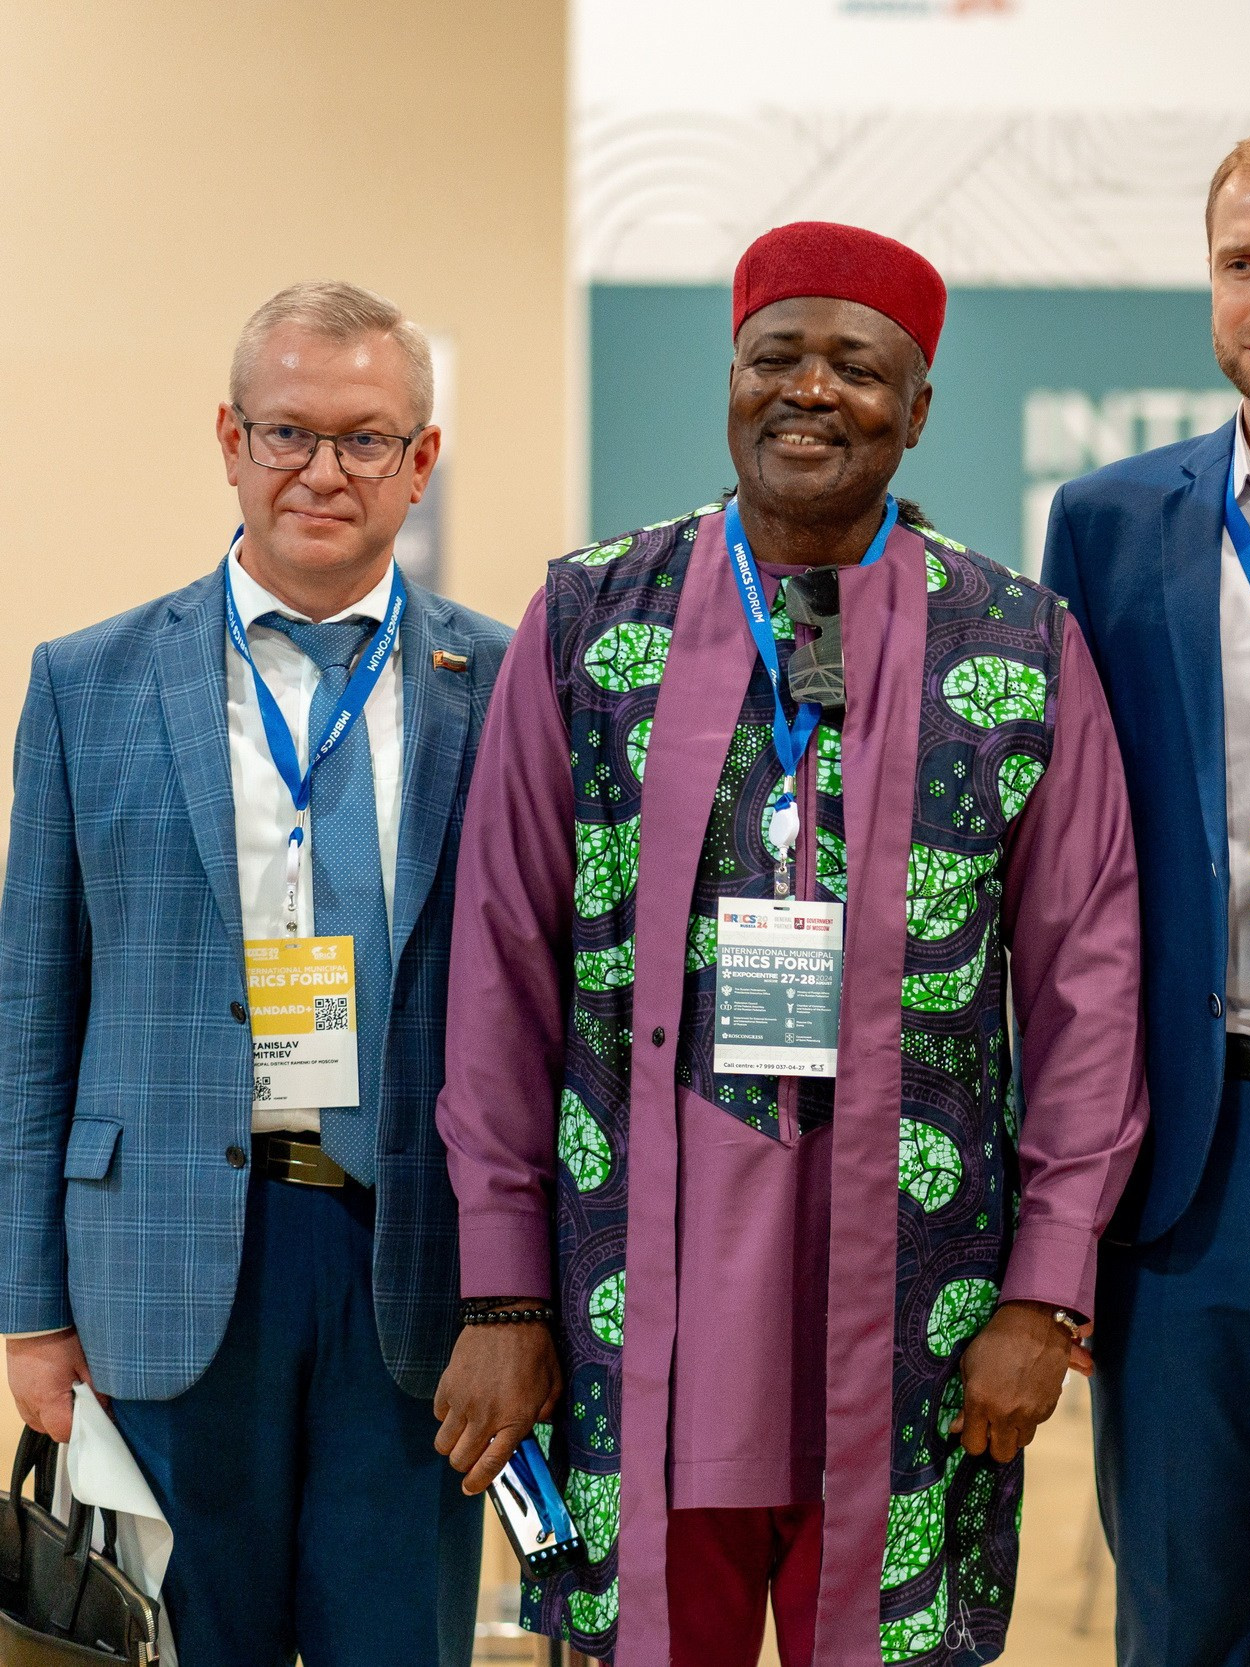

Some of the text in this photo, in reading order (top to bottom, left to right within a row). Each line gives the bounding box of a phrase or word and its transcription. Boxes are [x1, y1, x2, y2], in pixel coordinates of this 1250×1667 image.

[733, 542, 765, 623] IMBRICS FORUM
[367, 596, 402, 671] IMBRICS FORUM
[320, 709, 352, 753] IMBRICS
[723, 913, 757, 924] BRICS
[806, 917, 834, 925] GOVERNMENT
[721, 947, 833, 959] INTERNATIONAL MUNICIPAL
[304, 965, 347, 973] MUNICIPAL
[721, 954, 834, 972] BRICS FORUM
[247, 972, 349, 988] RICS FORUM
[732, 971, 779, 980] EXPOCENTRE
[780, 973, 816, 985] 27-28
[249, 1004, 312, 1016] TANDARD+
[253, 1041, 299, 1050] TANISLAV
[253, 1050, 291, 1059] MITRIEV
